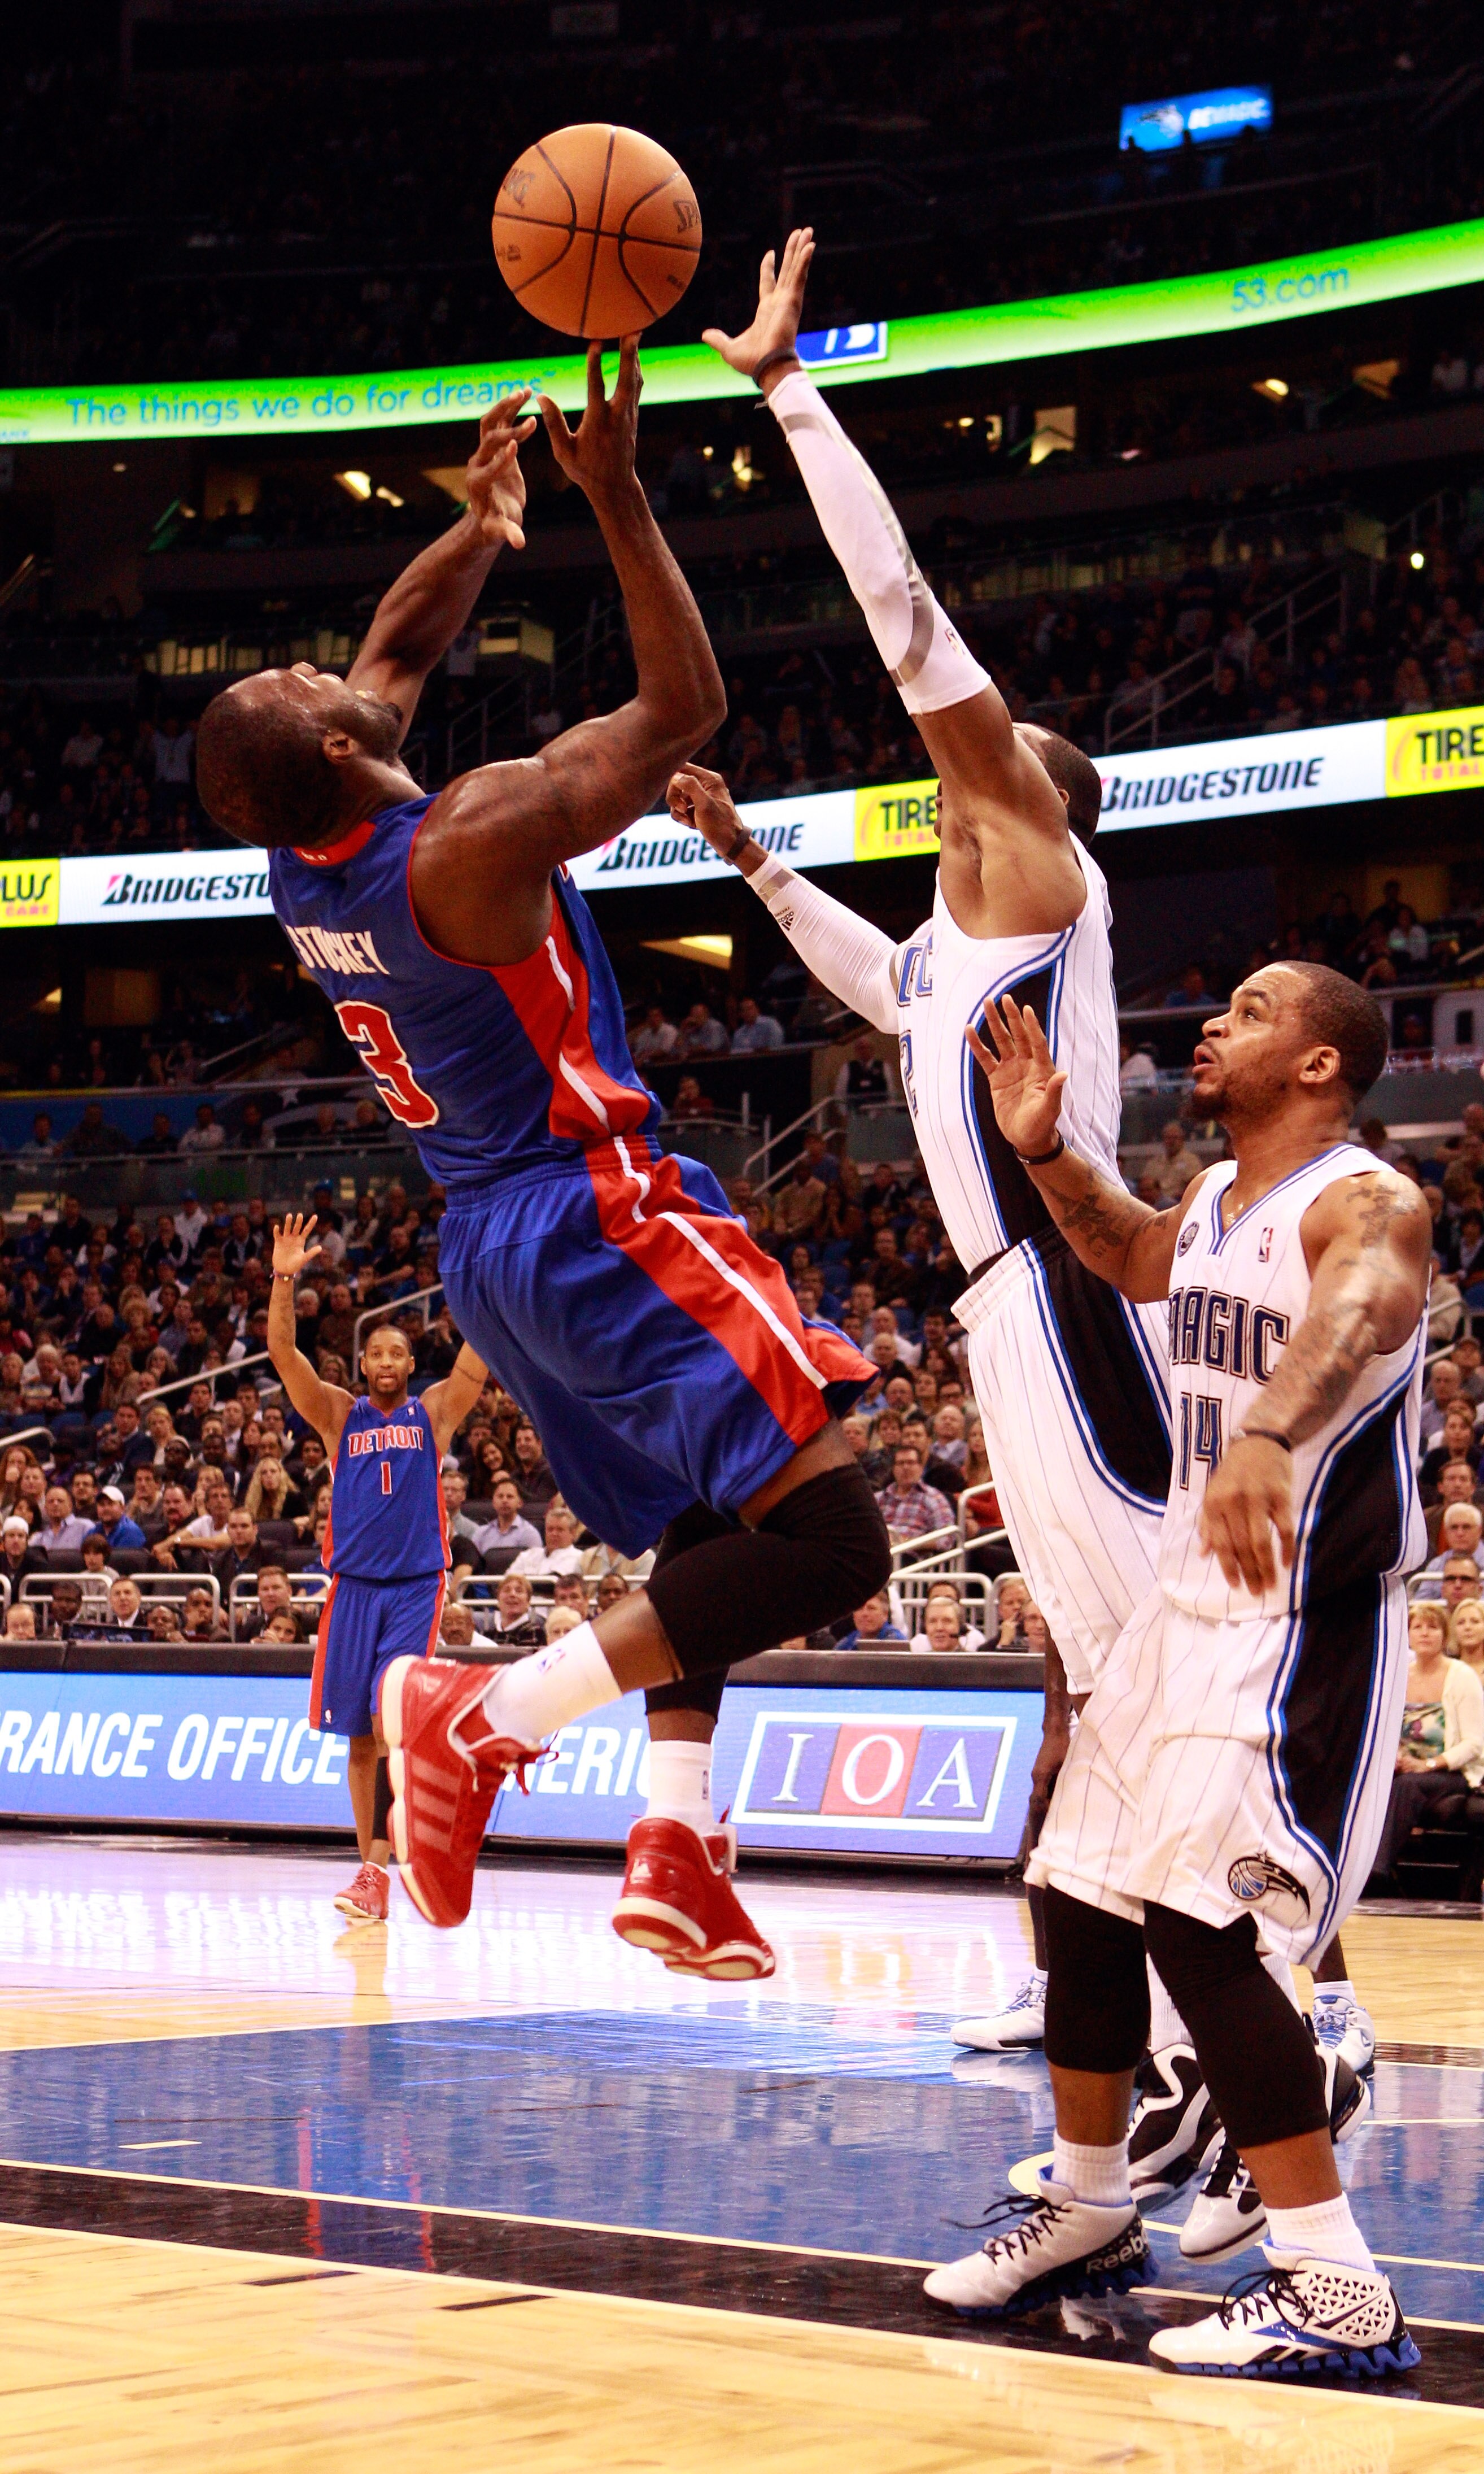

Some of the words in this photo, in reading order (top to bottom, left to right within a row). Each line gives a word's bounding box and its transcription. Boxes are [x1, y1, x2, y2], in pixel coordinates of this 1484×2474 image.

[1231, 267, 1348, 312] 53.com
[66, 397, 126, 425] The
[139, 394, 239, 427] things
[253, 397, 299, 418] we
[312, 388, 354, 416] do
[366, 384, 412, 412] for
[1100, 757, 1325, 812] BRIDGESTONE
[596, 824, 804, 873] BRIDGEONE
[0, 873, 51, 901] LUS
[285, 924, 391, 975] STUCKEY
[334, 1000, 439, 1129] 3
[348, 1425, 424, 1458] DETROIT
[381, 1461, 392, 1495] 1
[0, 1710, 163, 1778] RANCE
[167, 1713, 350, 1785] OFFICE
